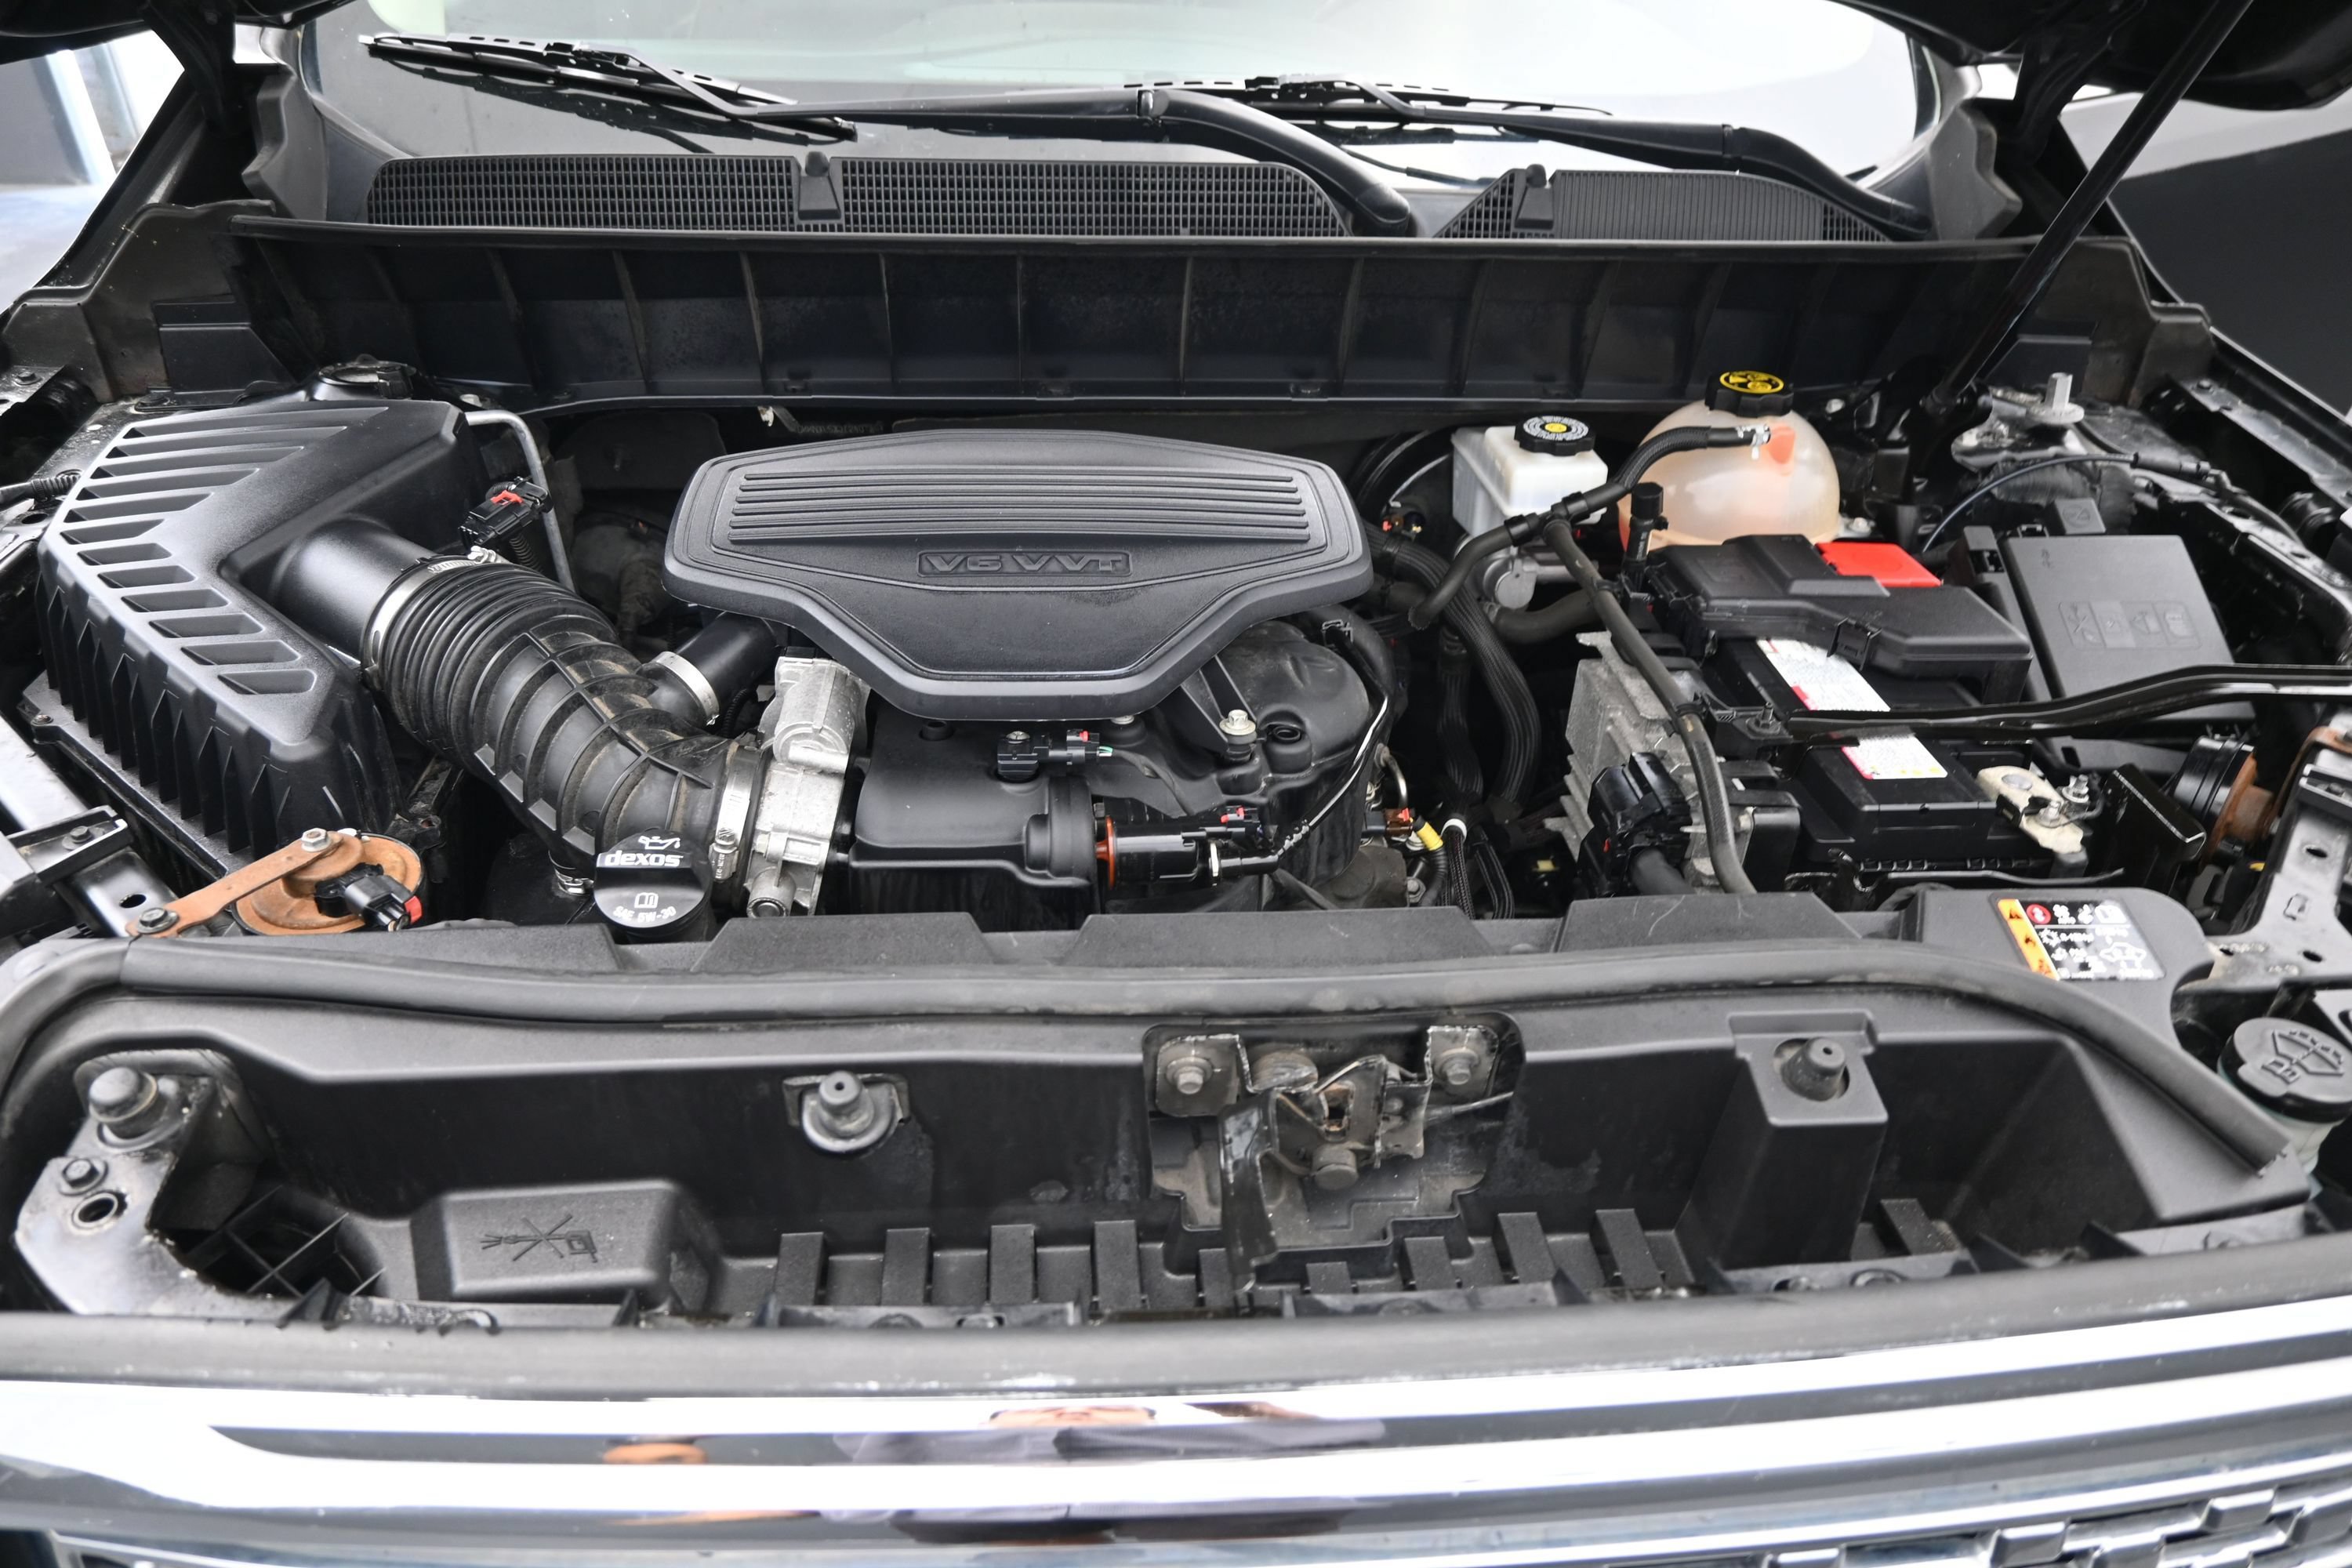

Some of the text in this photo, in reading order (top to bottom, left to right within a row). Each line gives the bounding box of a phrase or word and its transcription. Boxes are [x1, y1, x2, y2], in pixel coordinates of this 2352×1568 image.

[926, 554, 1123, 572] V6 VVT
[604, 850, 684, 867] dexos
[613, 906, 677, 923] SAE 5W-30
